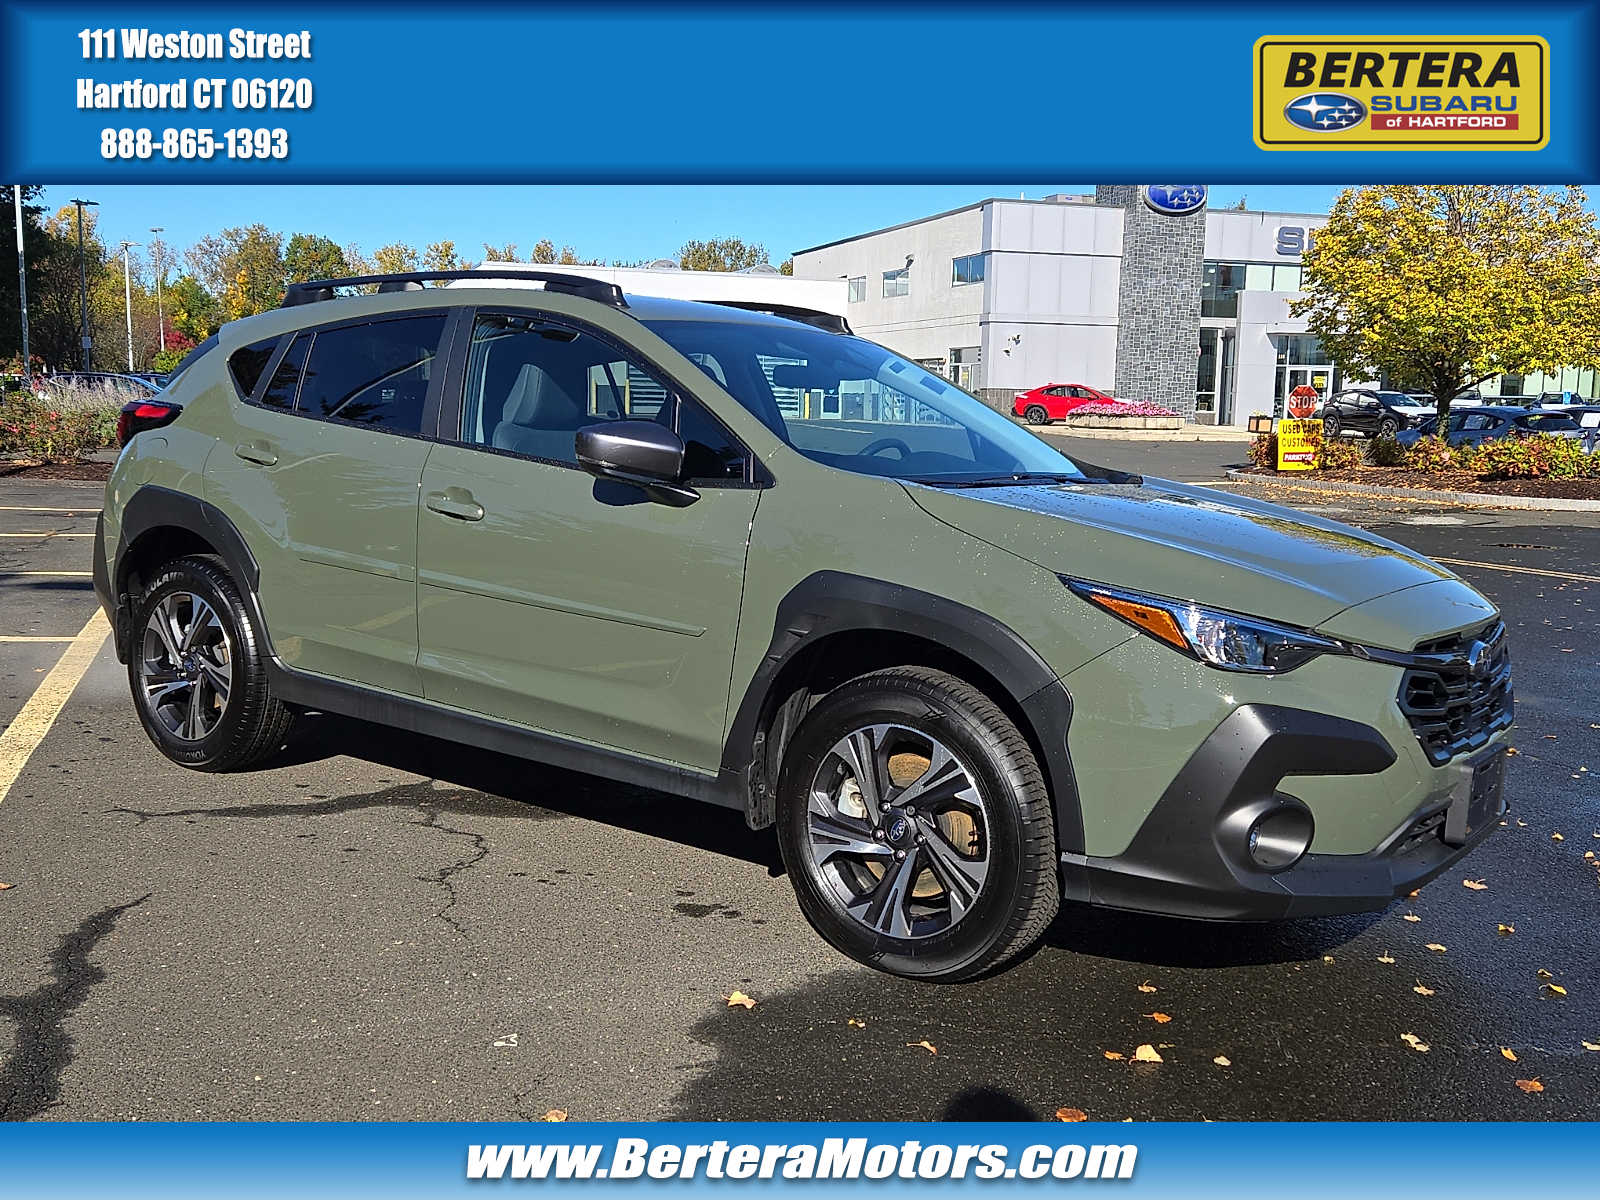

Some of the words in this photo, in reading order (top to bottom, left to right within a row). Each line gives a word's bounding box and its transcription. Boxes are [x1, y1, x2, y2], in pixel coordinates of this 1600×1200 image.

[1290, 395, 1317, 408] STOP
[1282, 424, 1301, 434] USED
[1302, 424, 1320, 434] CARS
